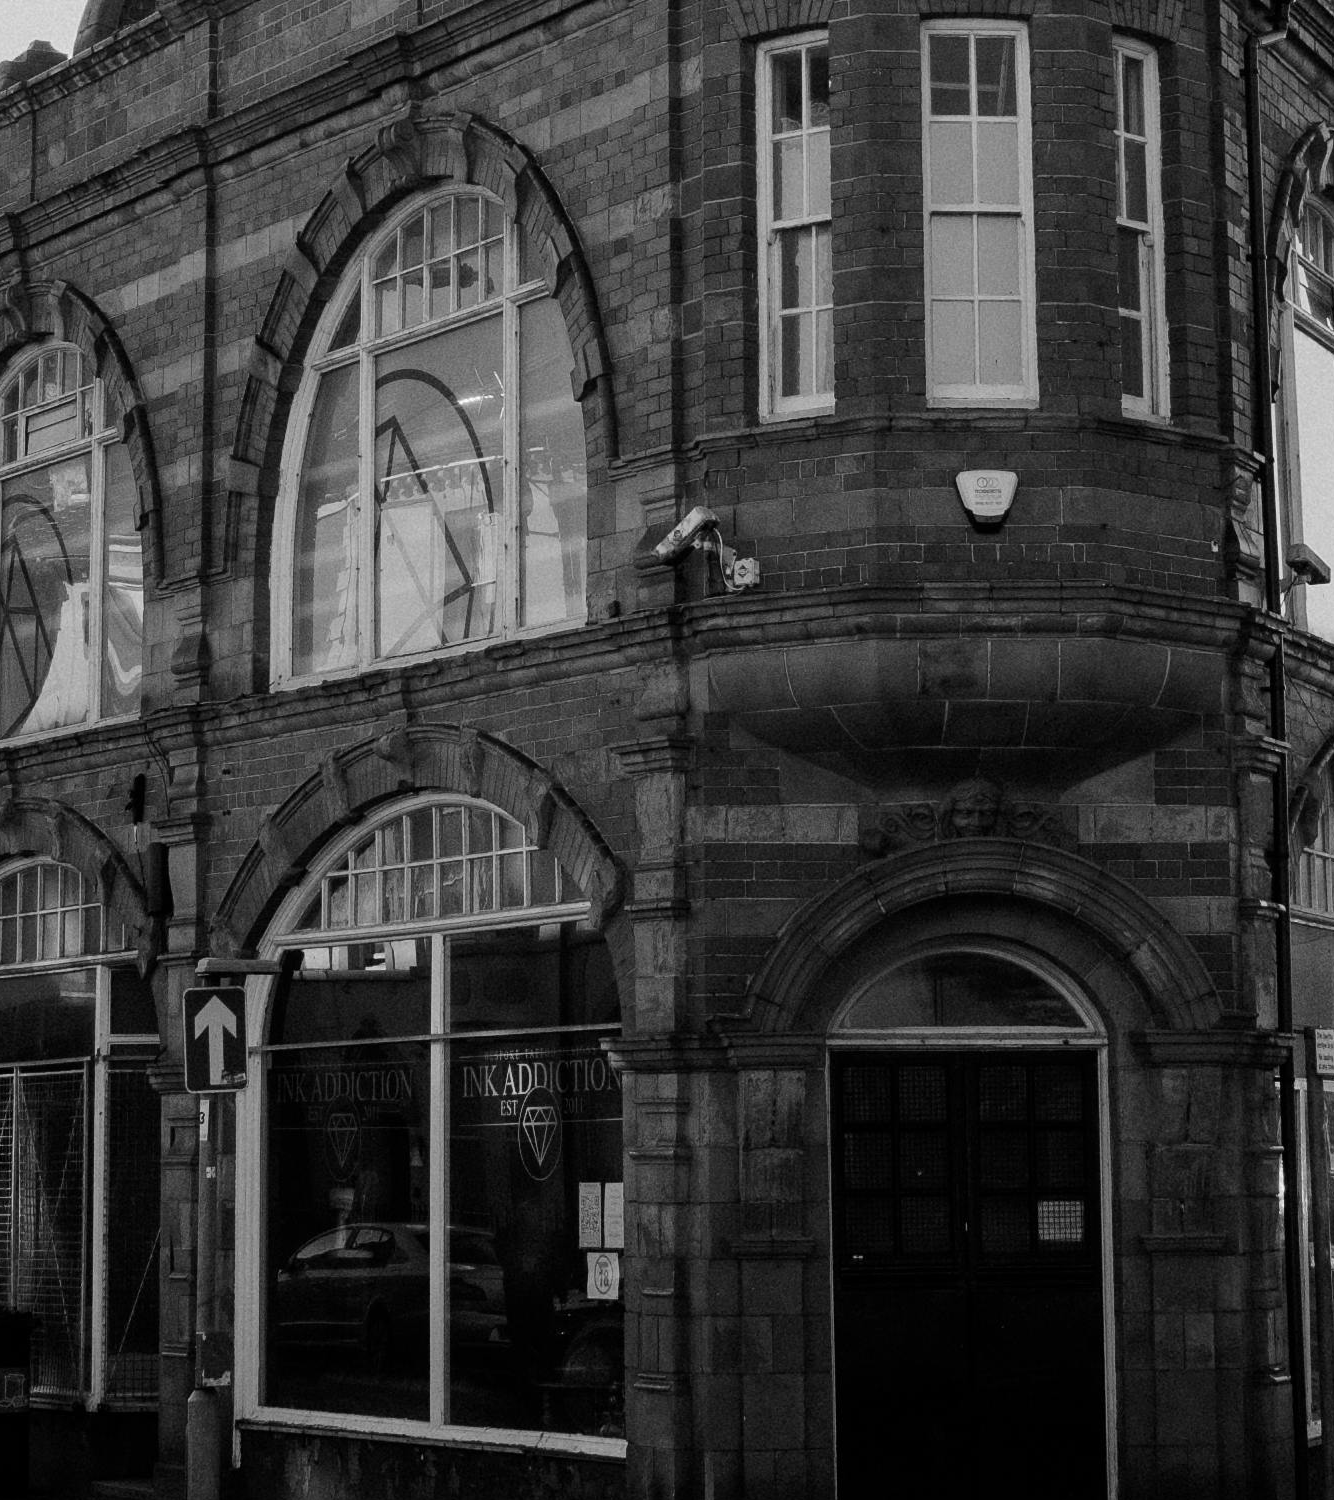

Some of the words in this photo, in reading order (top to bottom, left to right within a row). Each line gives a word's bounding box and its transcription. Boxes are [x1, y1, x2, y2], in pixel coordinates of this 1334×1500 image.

[276, 1072, 308, 1103] INK
[311, 1069, 413, 1102] ADDICTION
[462, 1065, 499, 1098] INK
[503, 1058, 622, 1096] ADDICTION
[500, 1099, 519, 1117] EST
